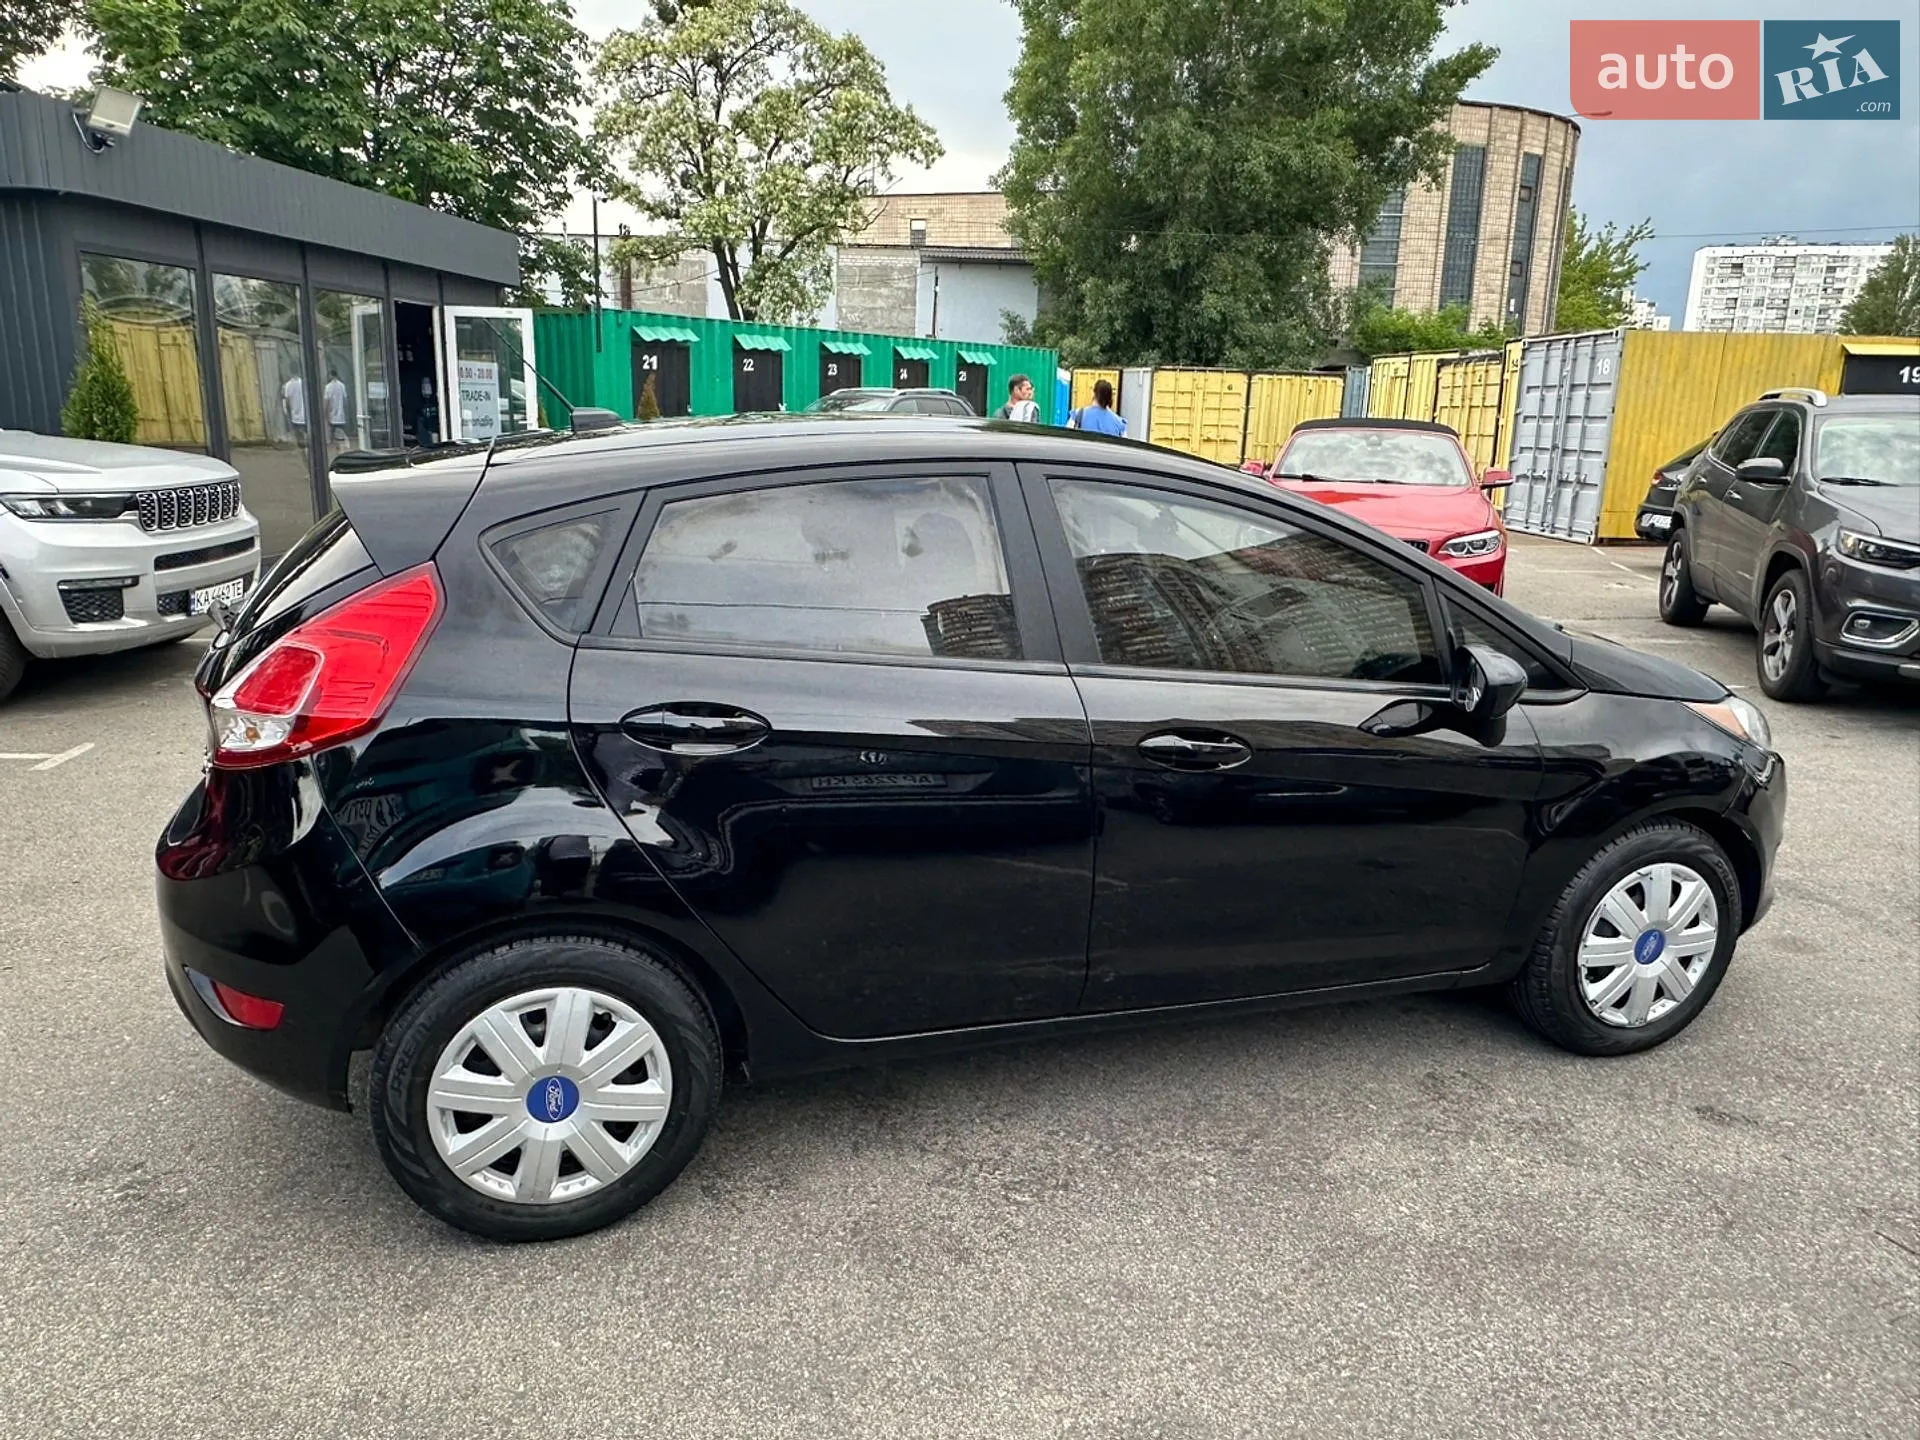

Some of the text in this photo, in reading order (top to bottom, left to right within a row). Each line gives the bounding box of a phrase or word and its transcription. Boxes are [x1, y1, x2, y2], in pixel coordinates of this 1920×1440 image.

[642, 354, 658, 370] 21
[743, 359, 754, 371] 22
[1595, 358, 1610, 375] 18
[827, 363, 838, 376] 23
[461, 390, 492, 401] TRADE-IN
